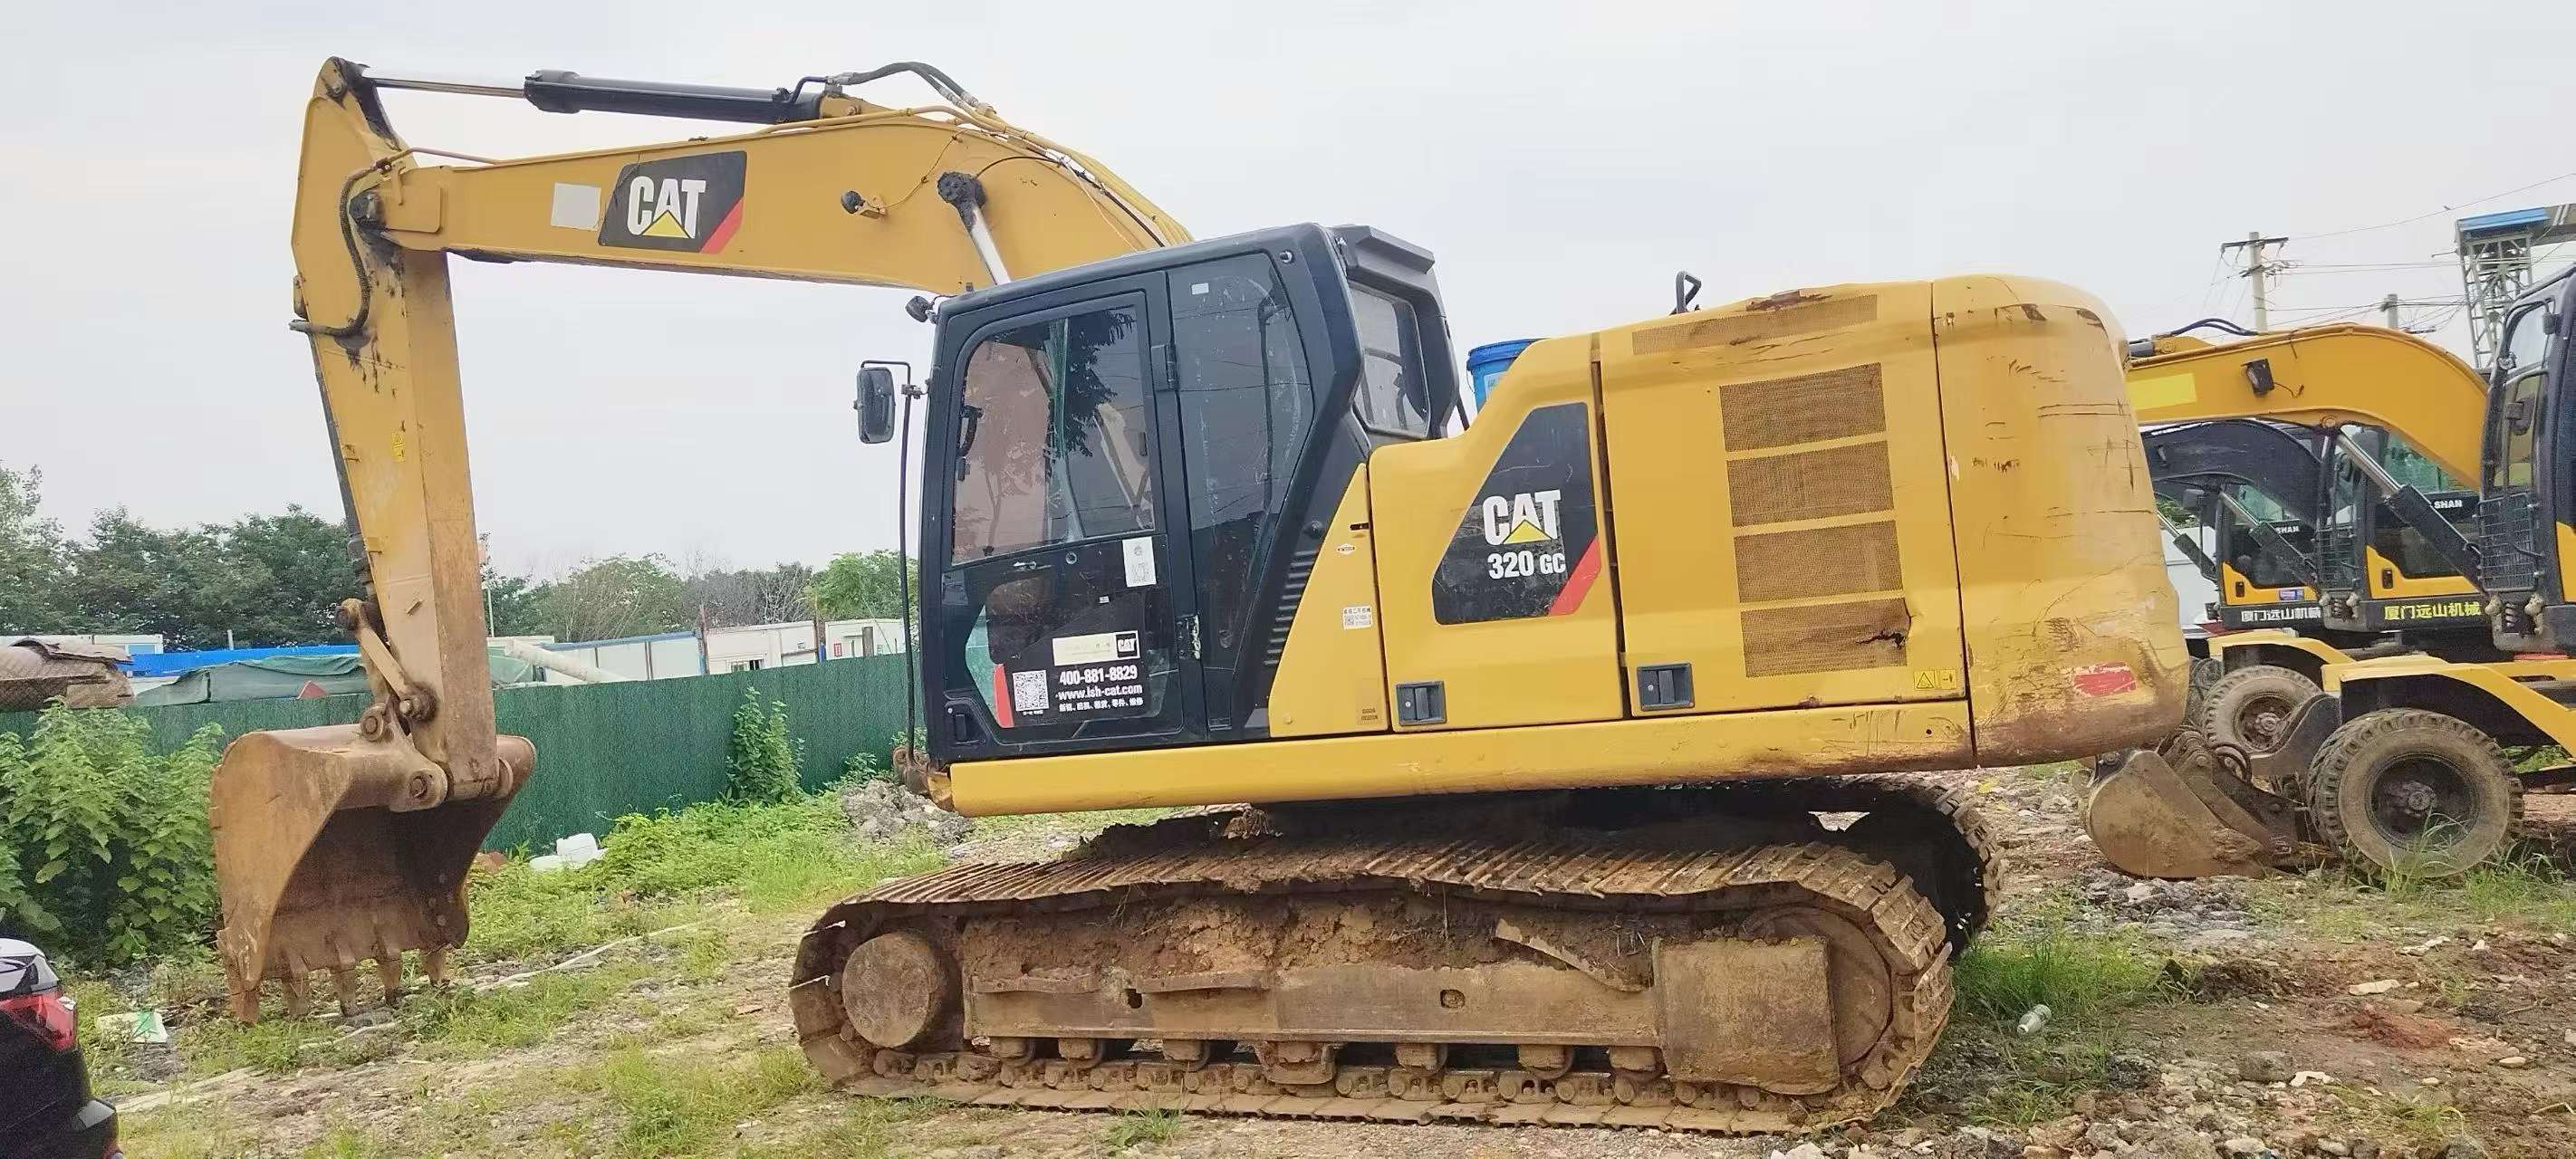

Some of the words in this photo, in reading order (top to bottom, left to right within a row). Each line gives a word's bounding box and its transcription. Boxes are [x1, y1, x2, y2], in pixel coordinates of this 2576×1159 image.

[627, 176, 706, 239] CAT
[2434, 499, 2463, 509] SHAN
[1482, 489, 1562, 546] CAT
[1487, 550, 1534, 580] 320
[1539, 552, 1567, 575] GC
[2384, 601, 2482, 620] 厦门远山机械
[1117, 638, 1138, 652] CAT
[1059, 665, 1139, 685] 400-881-8829
